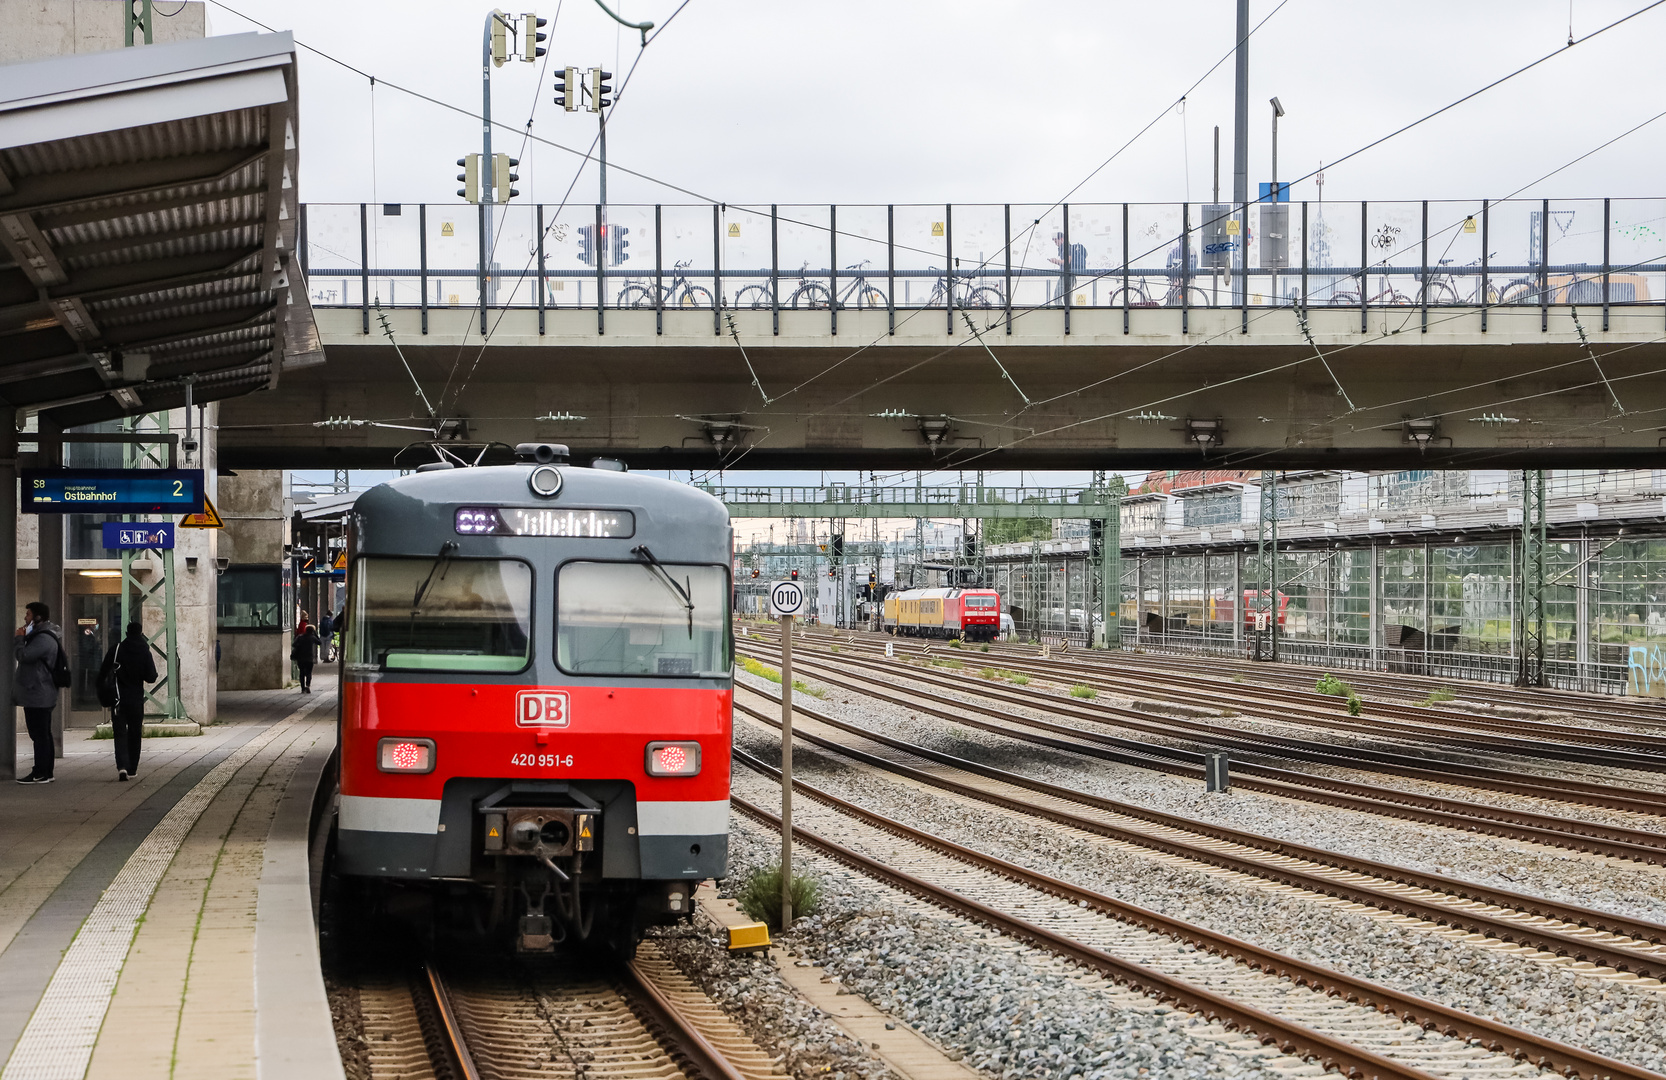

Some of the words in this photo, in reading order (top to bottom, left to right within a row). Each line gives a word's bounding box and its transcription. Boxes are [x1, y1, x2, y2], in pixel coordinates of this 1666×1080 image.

[33, 480, 45, 489] S8
[172, 480, 184, 497] 2
[64, 491, 117, 501] Ostbahnhof
[777, 590, 797, 605] 010
[523, 696, 563, 721] DB
[511, 753, 536, 767] 420
[538, 754, 574, 767] 951-6
